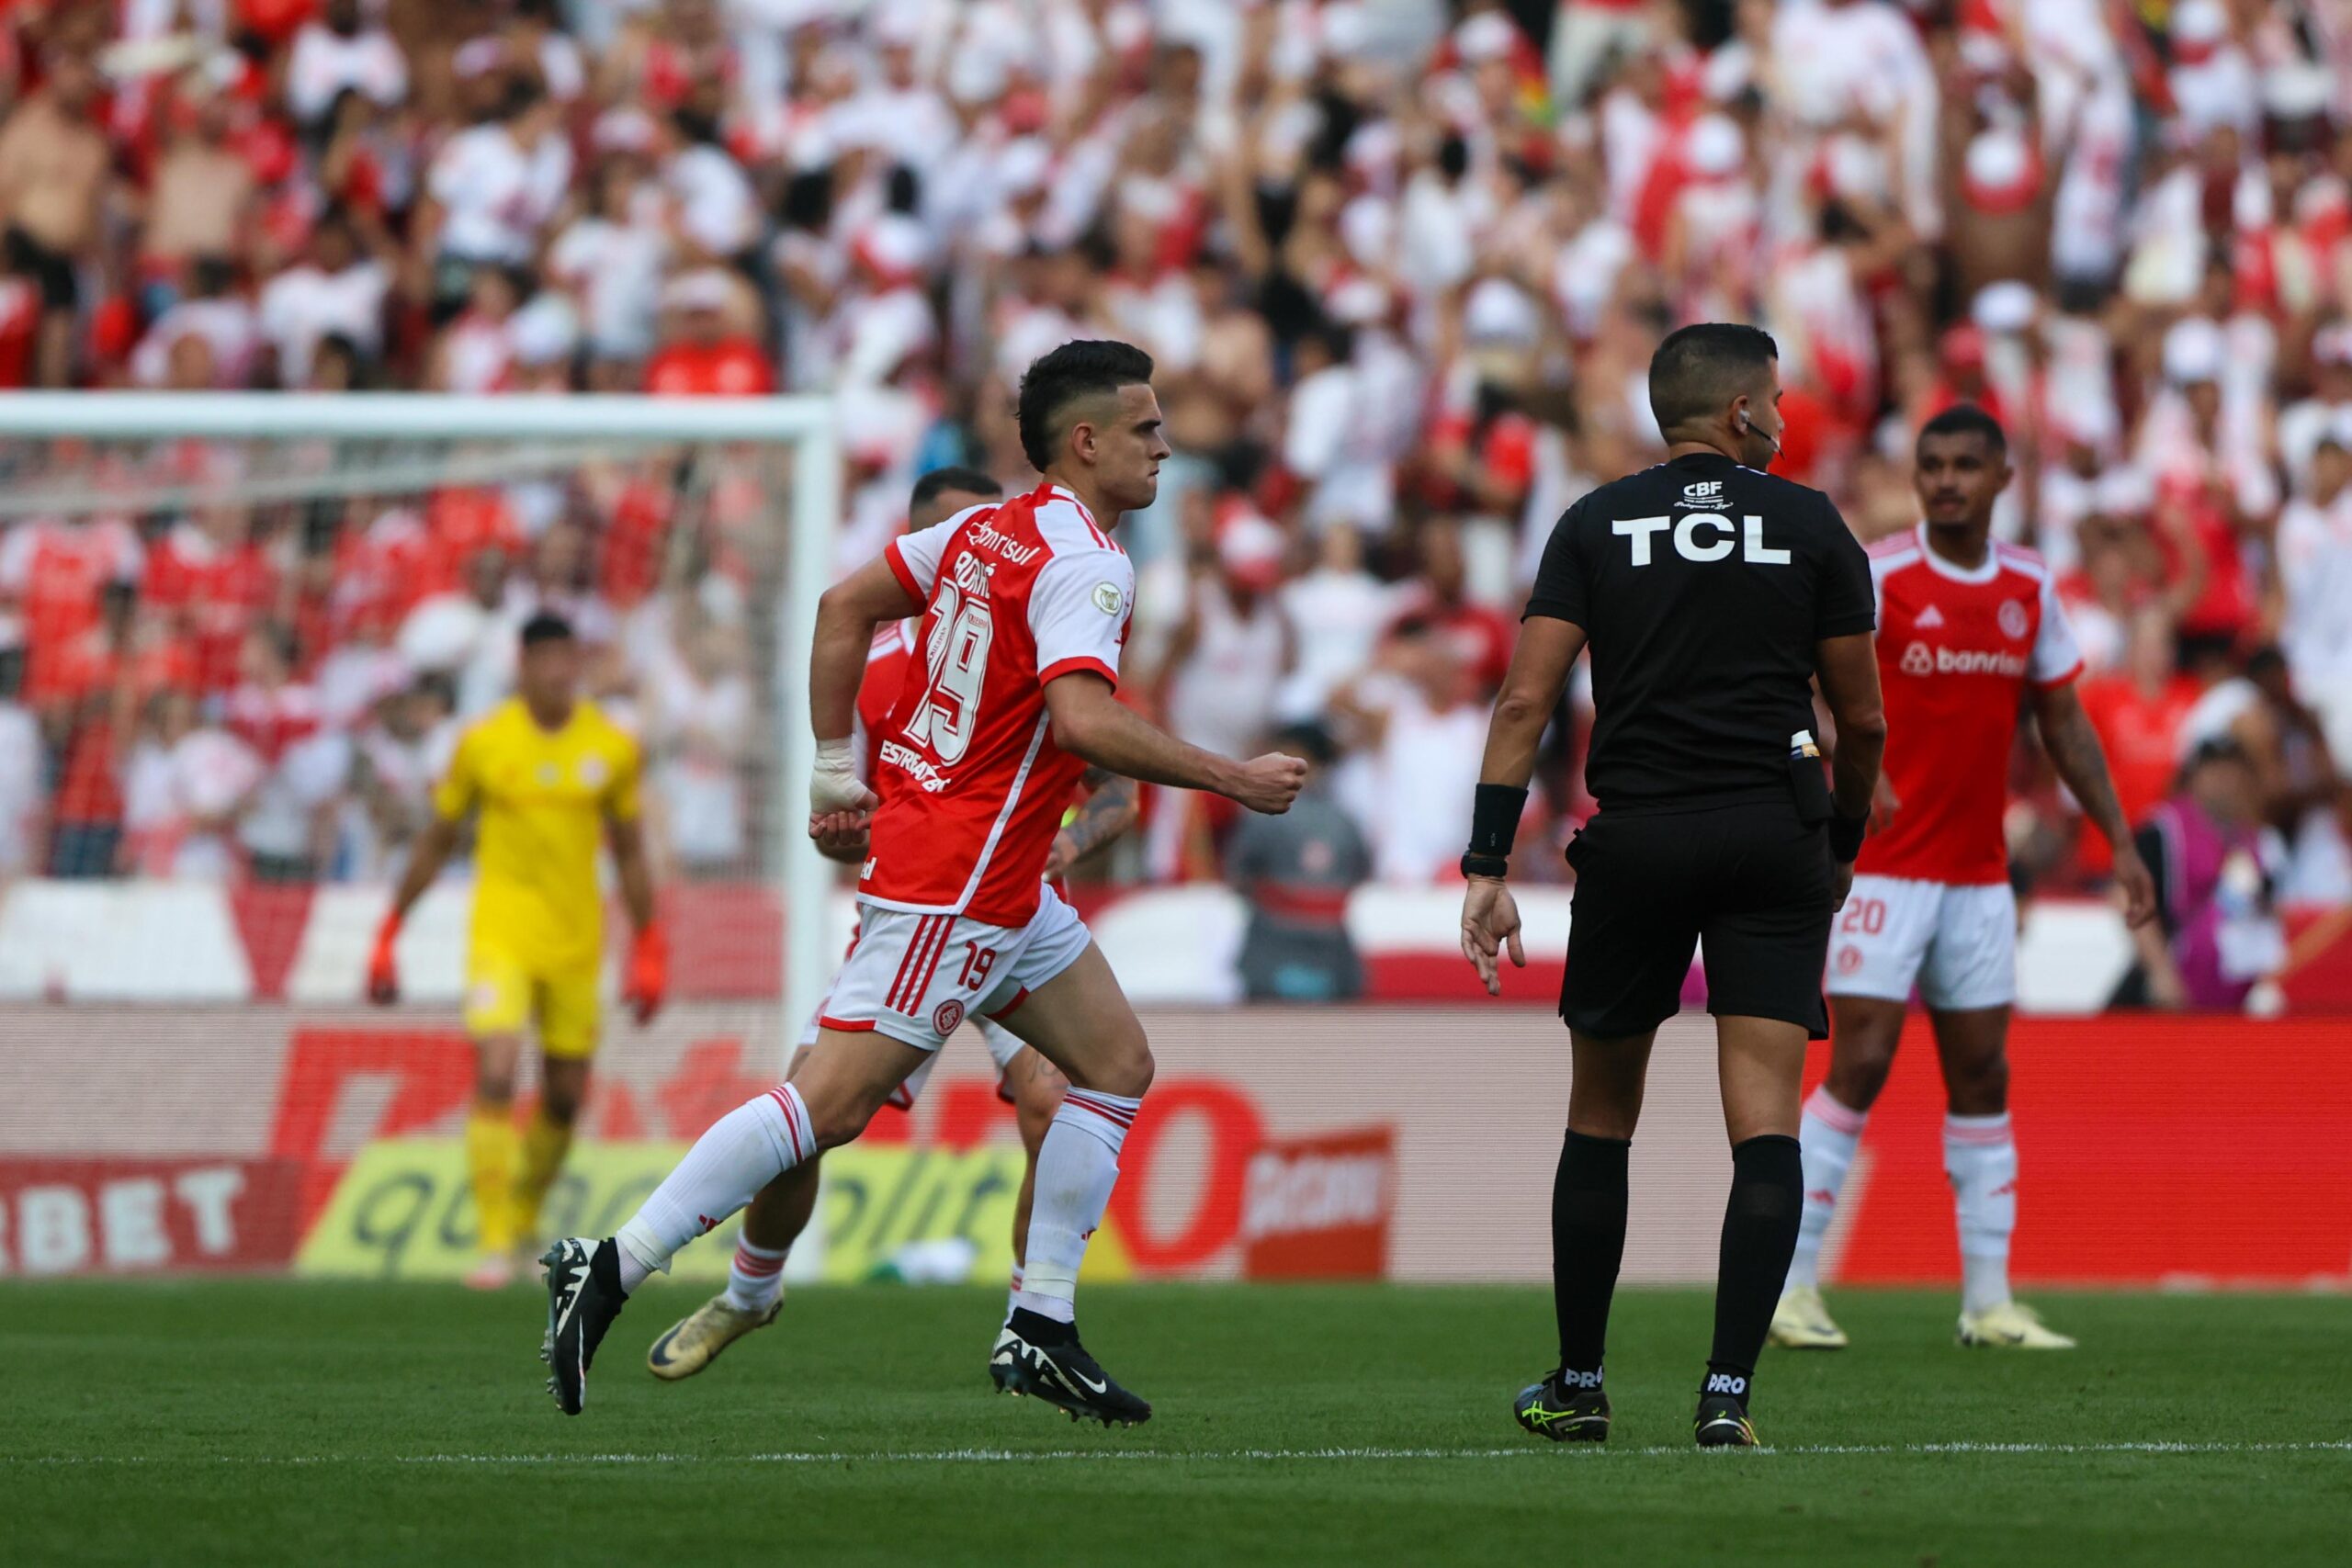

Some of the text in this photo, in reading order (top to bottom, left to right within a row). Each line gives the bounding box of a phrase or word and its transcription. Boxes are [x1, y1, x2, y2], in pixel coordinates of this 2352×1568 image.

[1683, 480, 1724, 497] CBF
[1611, 513, 1792, 568] TCL
[900, 575, 994, 768] 19
[1841, 897, 1886, 935] 20
[957, 940, 997, 992] 19
[0, 1164, 244, 1275] BET
[1707, 1372, 1747, 1395] PRO
